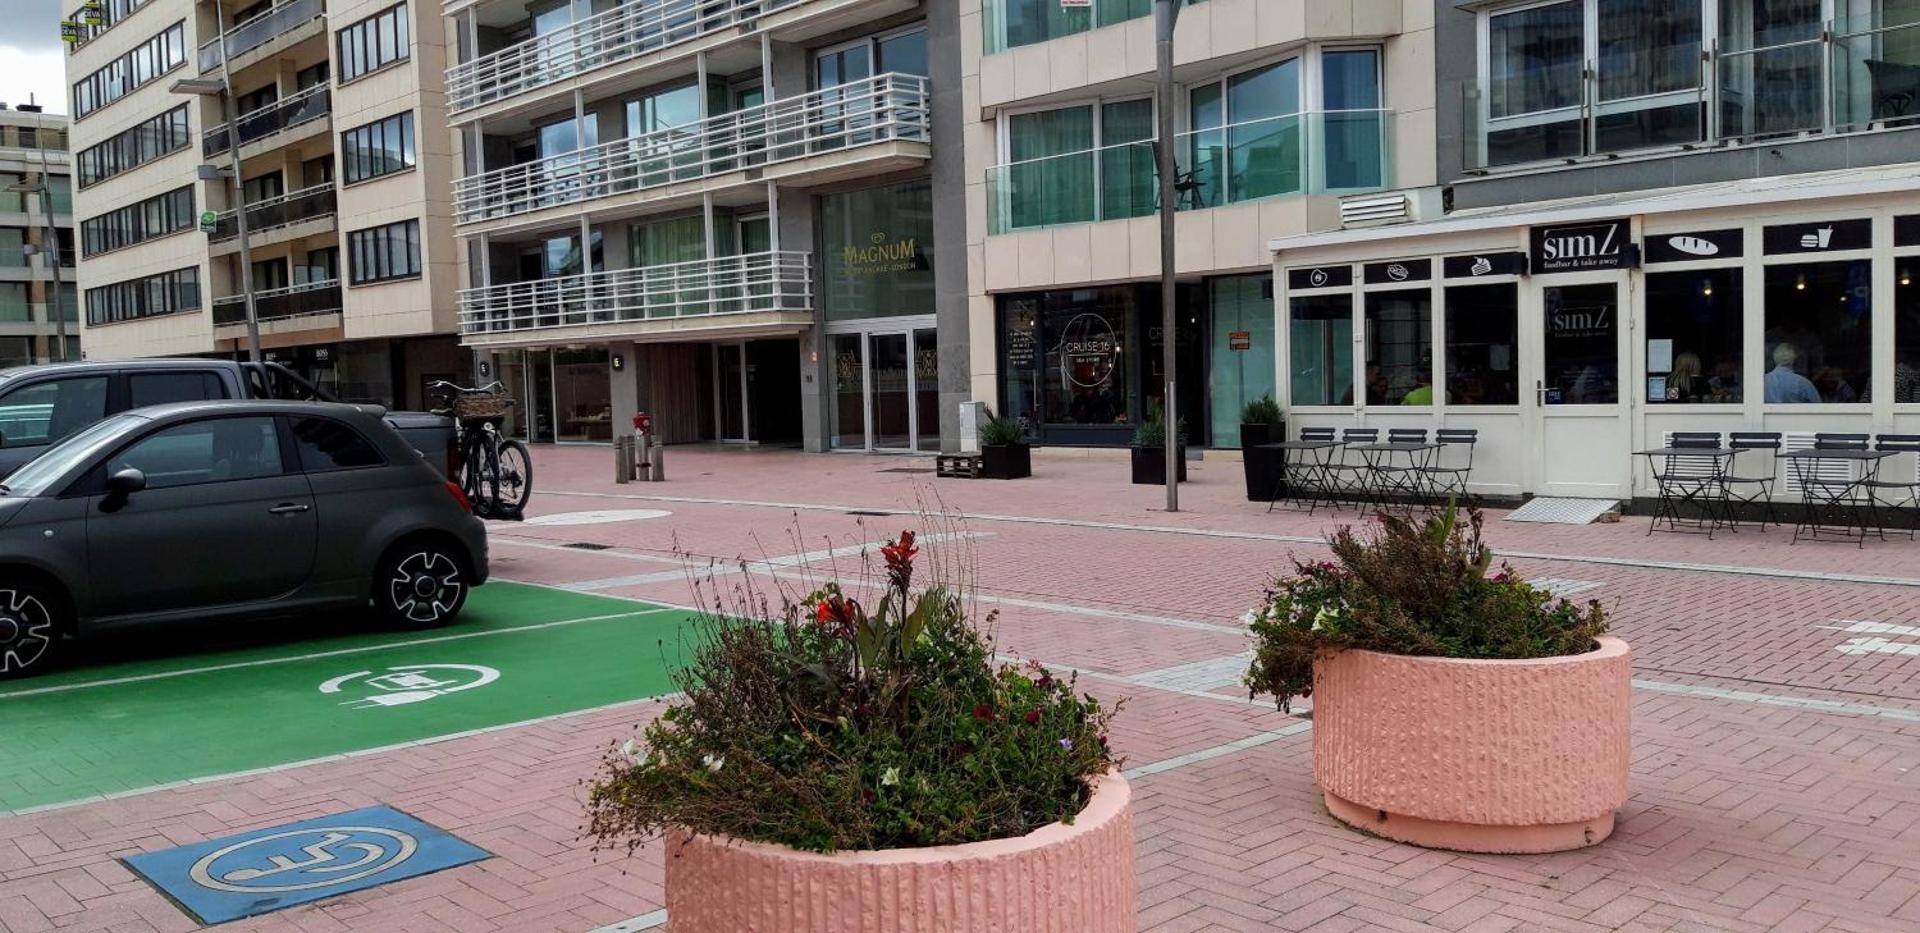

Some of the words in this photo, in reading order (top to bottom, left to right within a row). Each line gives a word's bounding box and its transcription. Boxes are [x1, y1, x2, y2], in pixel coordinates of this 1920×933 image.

[845, 238, 915, 265] MAGNUM
[1581, 258, 1596, 266] take
[1599, 257, 1618, 265] away
[1066, 341, 1098, 353] CRUISE
